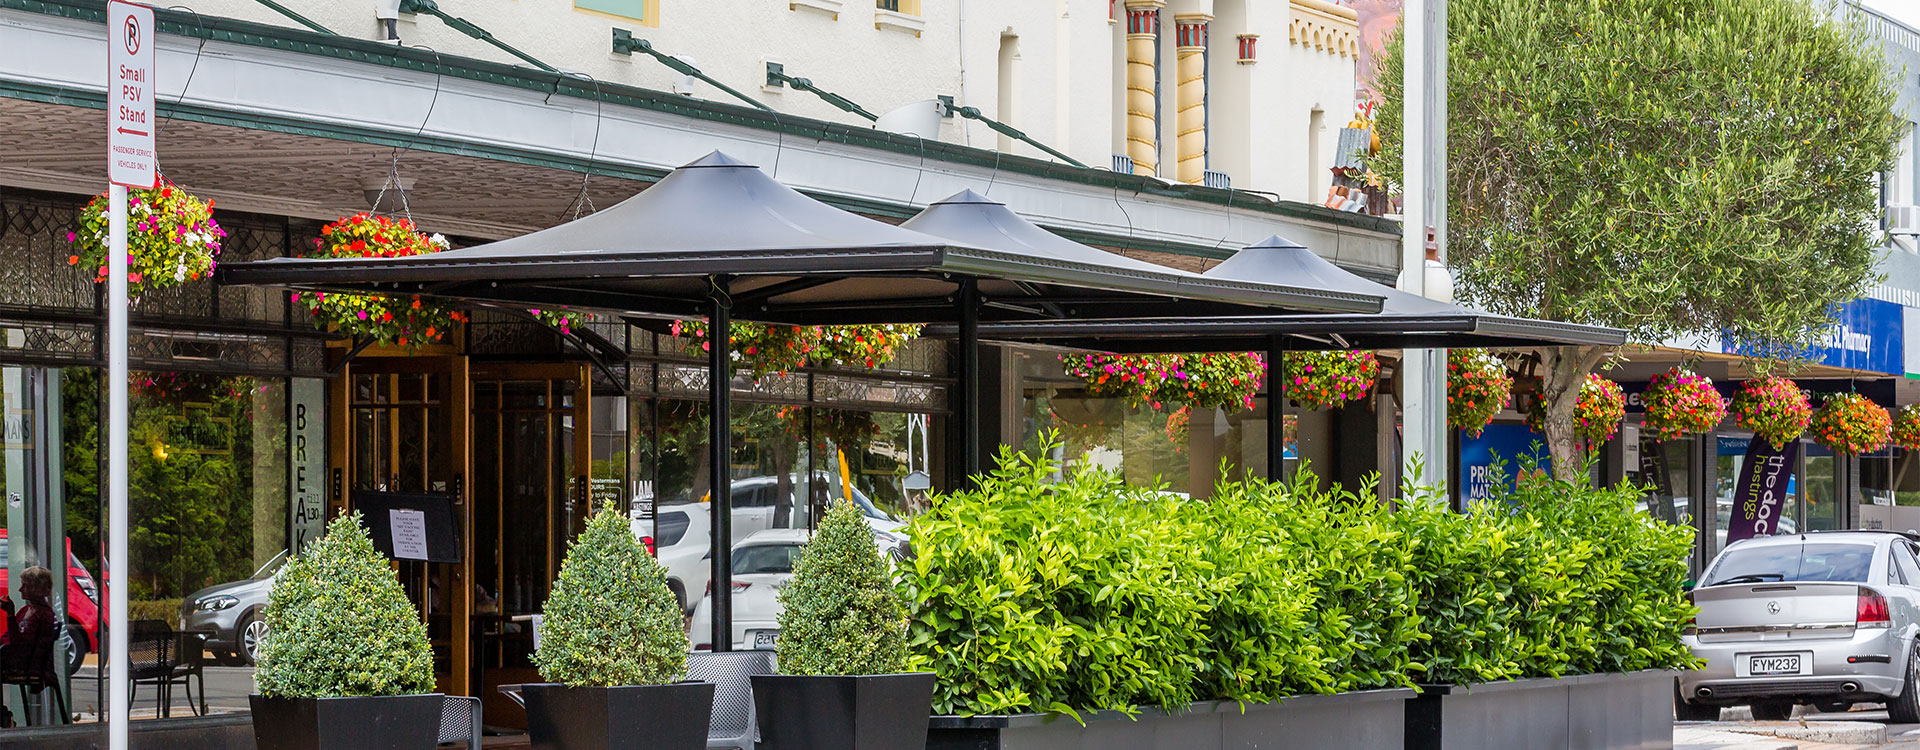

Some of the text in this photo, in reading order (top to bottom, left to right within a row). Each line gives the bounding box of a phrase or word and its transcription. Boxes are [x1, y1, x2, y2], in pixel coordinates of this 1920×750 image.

[120, 63, 145, 83] Small
[123, 84, 141, 102] PSV
[120, 104, 145, 124] Stand
[113, 145, 152, 158] PASSENGER SERVICE
[117, 160, 147, 170] VEHICLES ONLY
[1842, 324, 1871, 360] Pharmacy
[1743, 454, 1769, 520] hastings
[1752, 658, 1798, 671] FYM232
